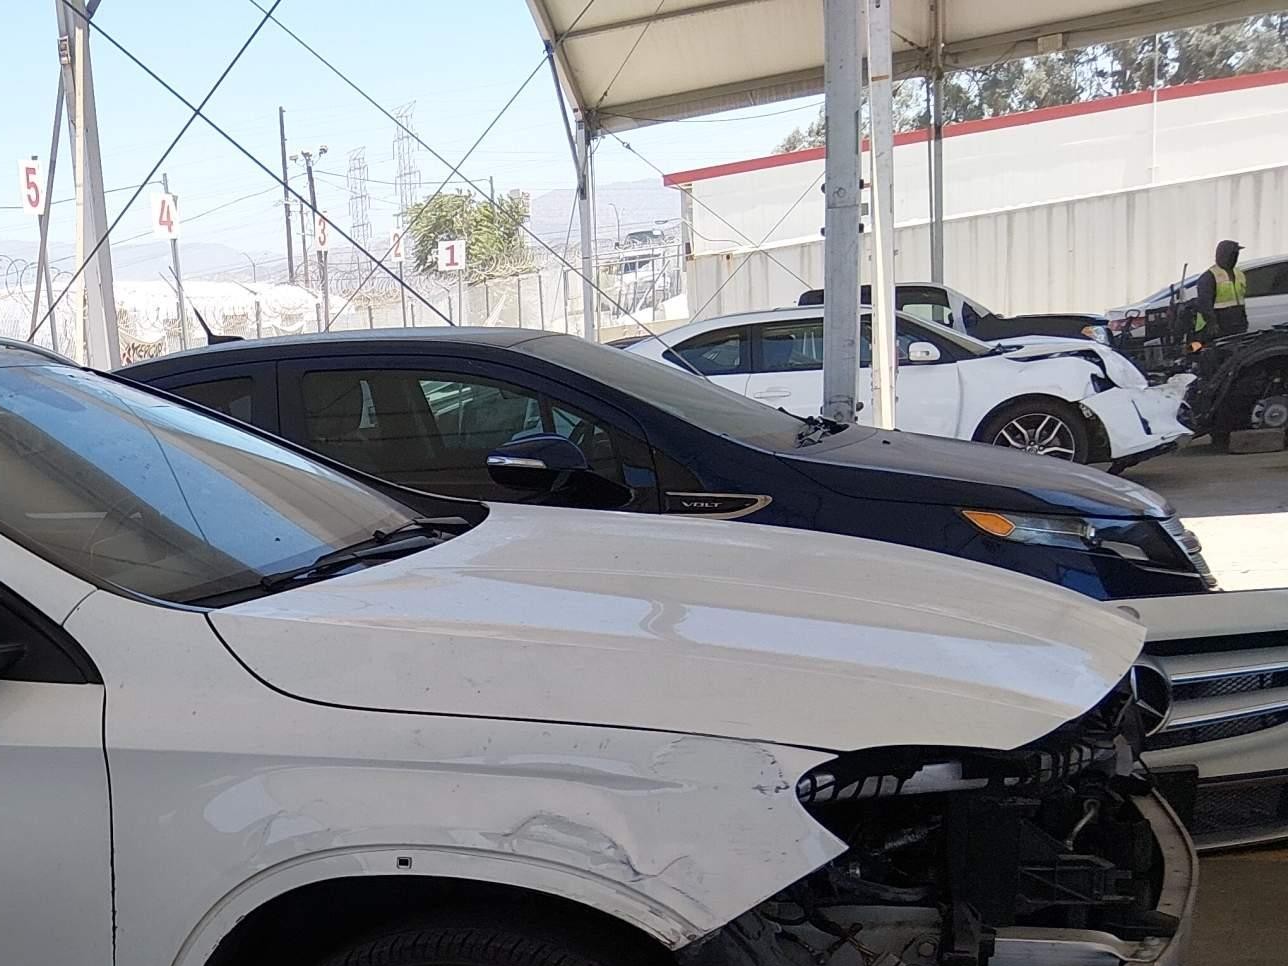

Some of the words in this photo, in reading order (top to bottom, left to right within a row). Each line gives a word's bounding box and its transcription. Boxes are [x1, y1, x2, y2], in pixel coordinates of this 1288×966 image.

[24, 167, 40, 208] 5
[158, 200, 174, 233] 4
[318, 218, 327, 246] 3
[393, 233, 402, 257] 2
[445, 244, 459, 267] 1
